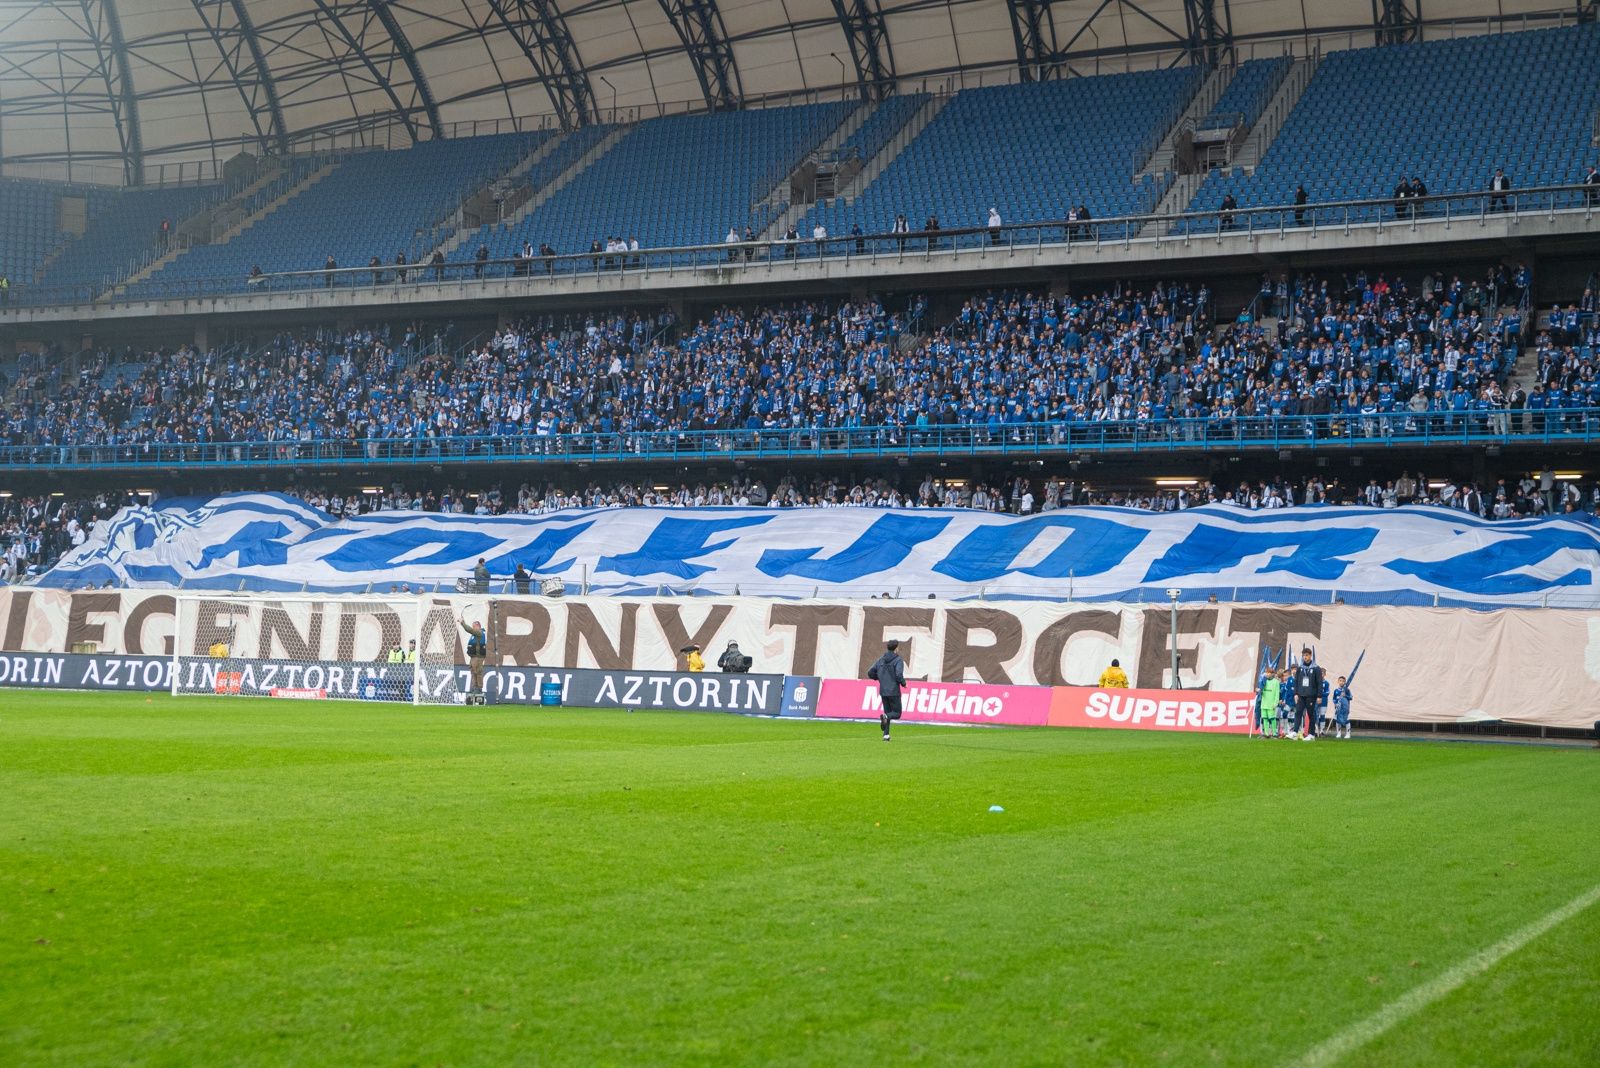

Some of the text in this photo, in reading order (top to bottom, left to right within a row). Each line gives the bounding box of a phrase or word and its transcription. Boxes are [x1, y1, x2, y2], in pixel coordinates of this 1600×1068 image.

[768, 603, 1322, 691] TERCET
[81, 659, 222, 688] AZTORIN
[595, 675, 771, 710] AZTORIN
